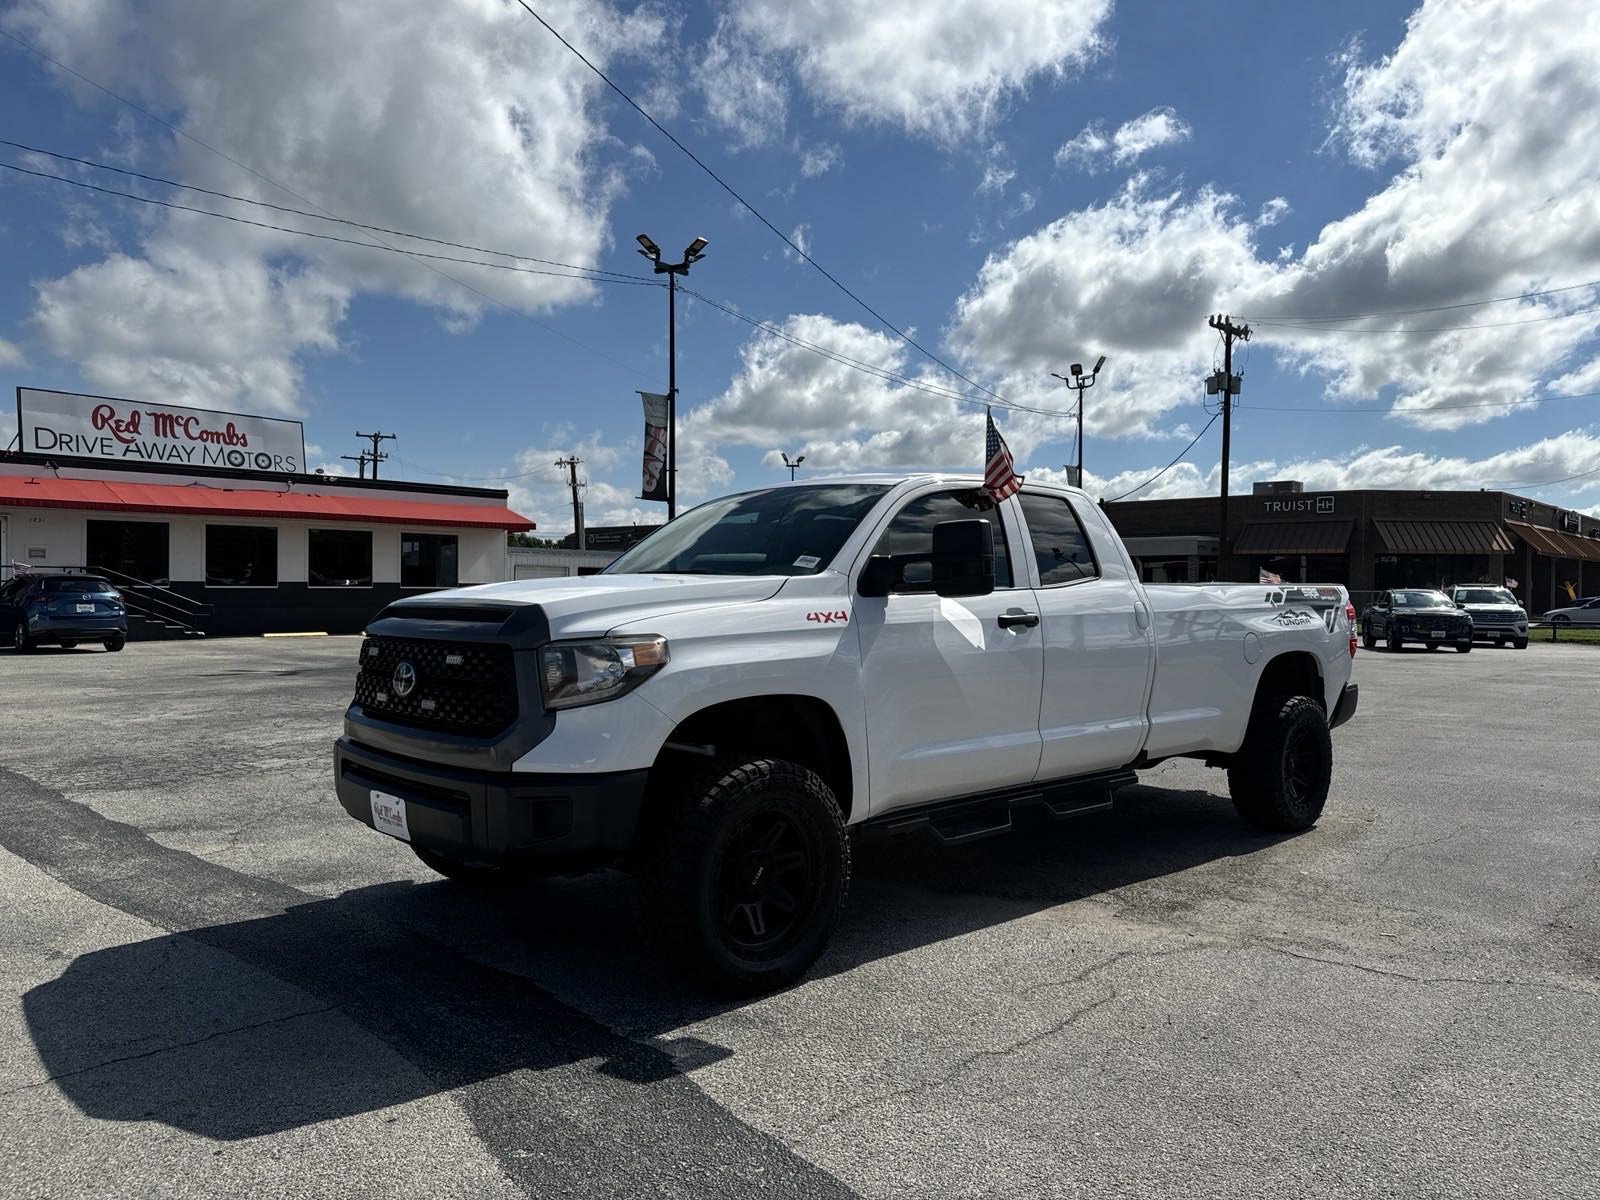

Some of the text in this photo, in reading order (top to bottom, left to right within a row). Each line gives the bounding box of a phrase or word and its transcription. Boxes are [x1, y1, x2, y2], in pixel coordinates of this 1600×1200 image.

[92, 404, 248, 447] Red McCombs
[34, 426, 297, 472] DRIVE AWAY MOTORS
[1264, 500, 1314, 512] TRUIST
[1277, 618, 1311, 627] TUNDRA
